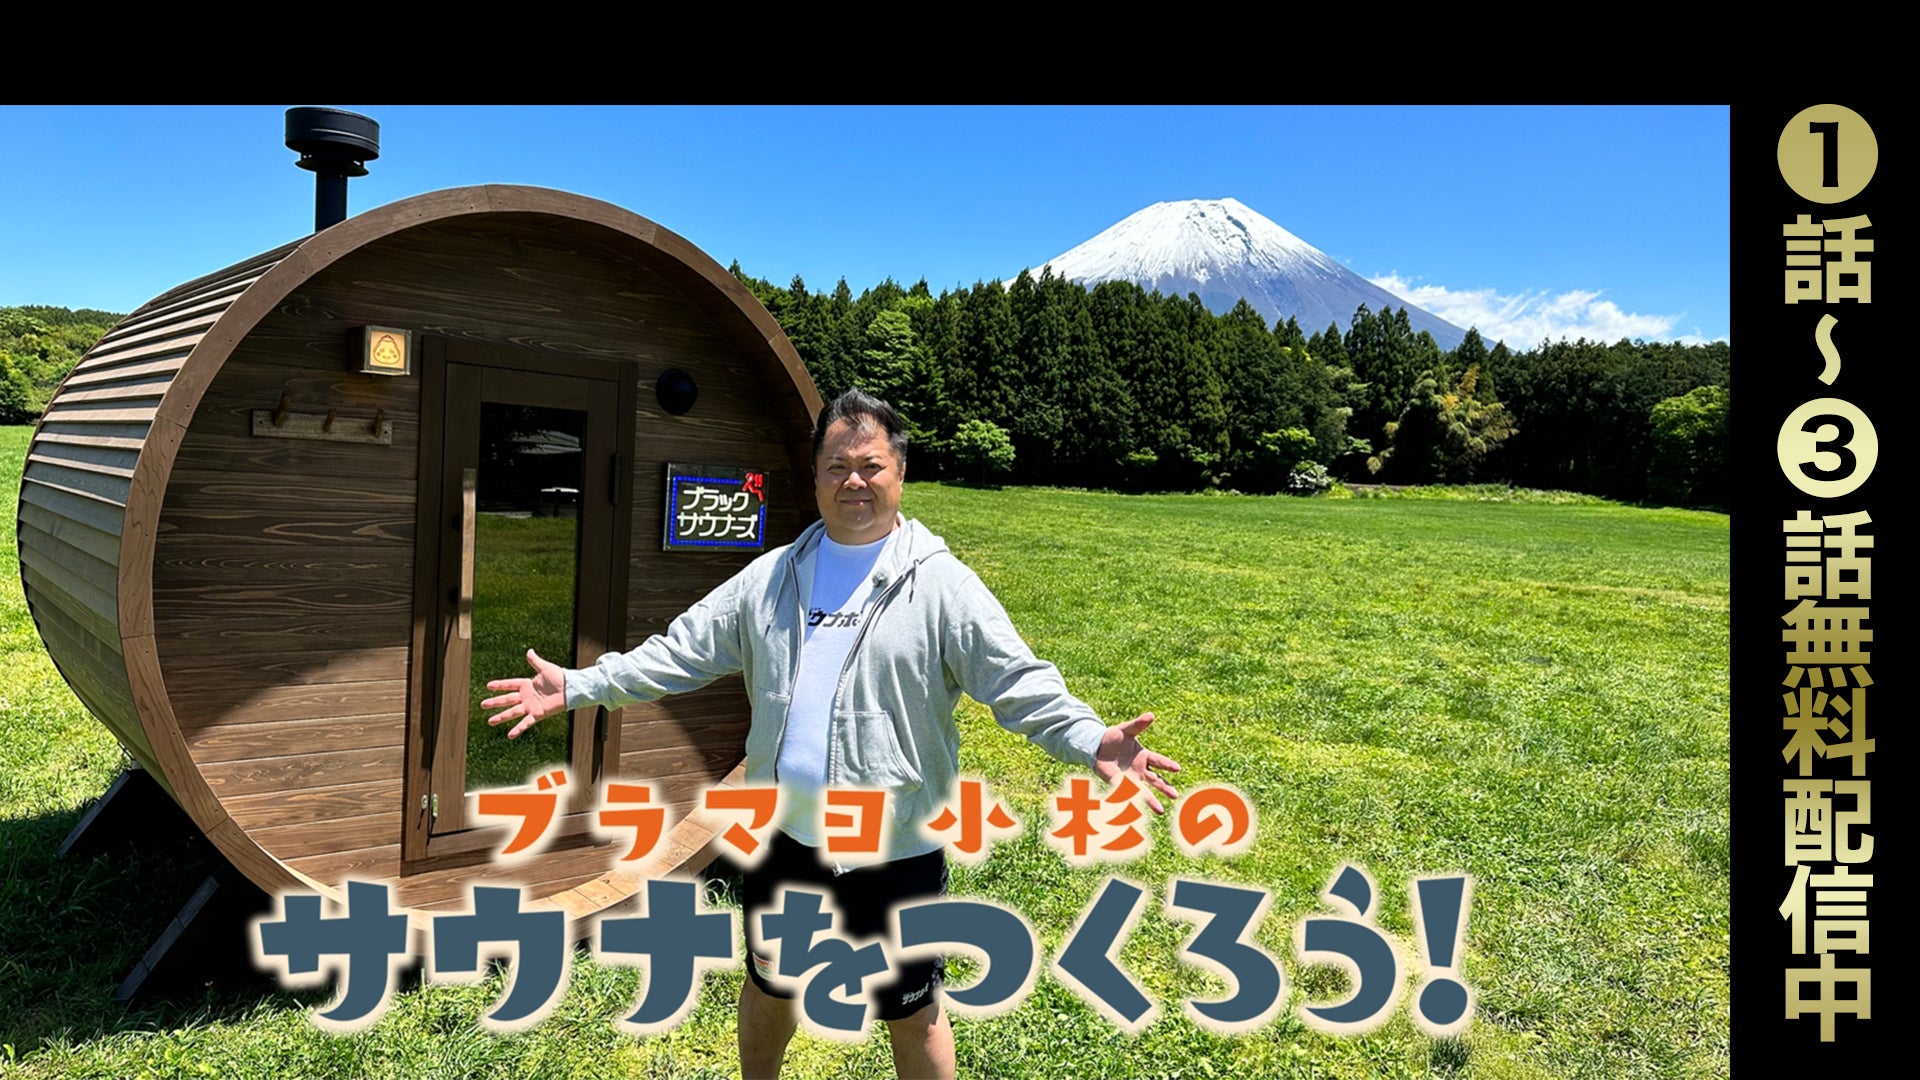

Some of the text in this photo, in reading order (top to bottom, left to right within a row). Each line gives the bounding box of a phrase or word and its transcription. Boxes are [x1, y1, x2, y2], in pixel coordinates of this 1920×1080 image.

[682, 486, 749, 512] ブラック
[677, 511, 758, 539] サウナーズ
